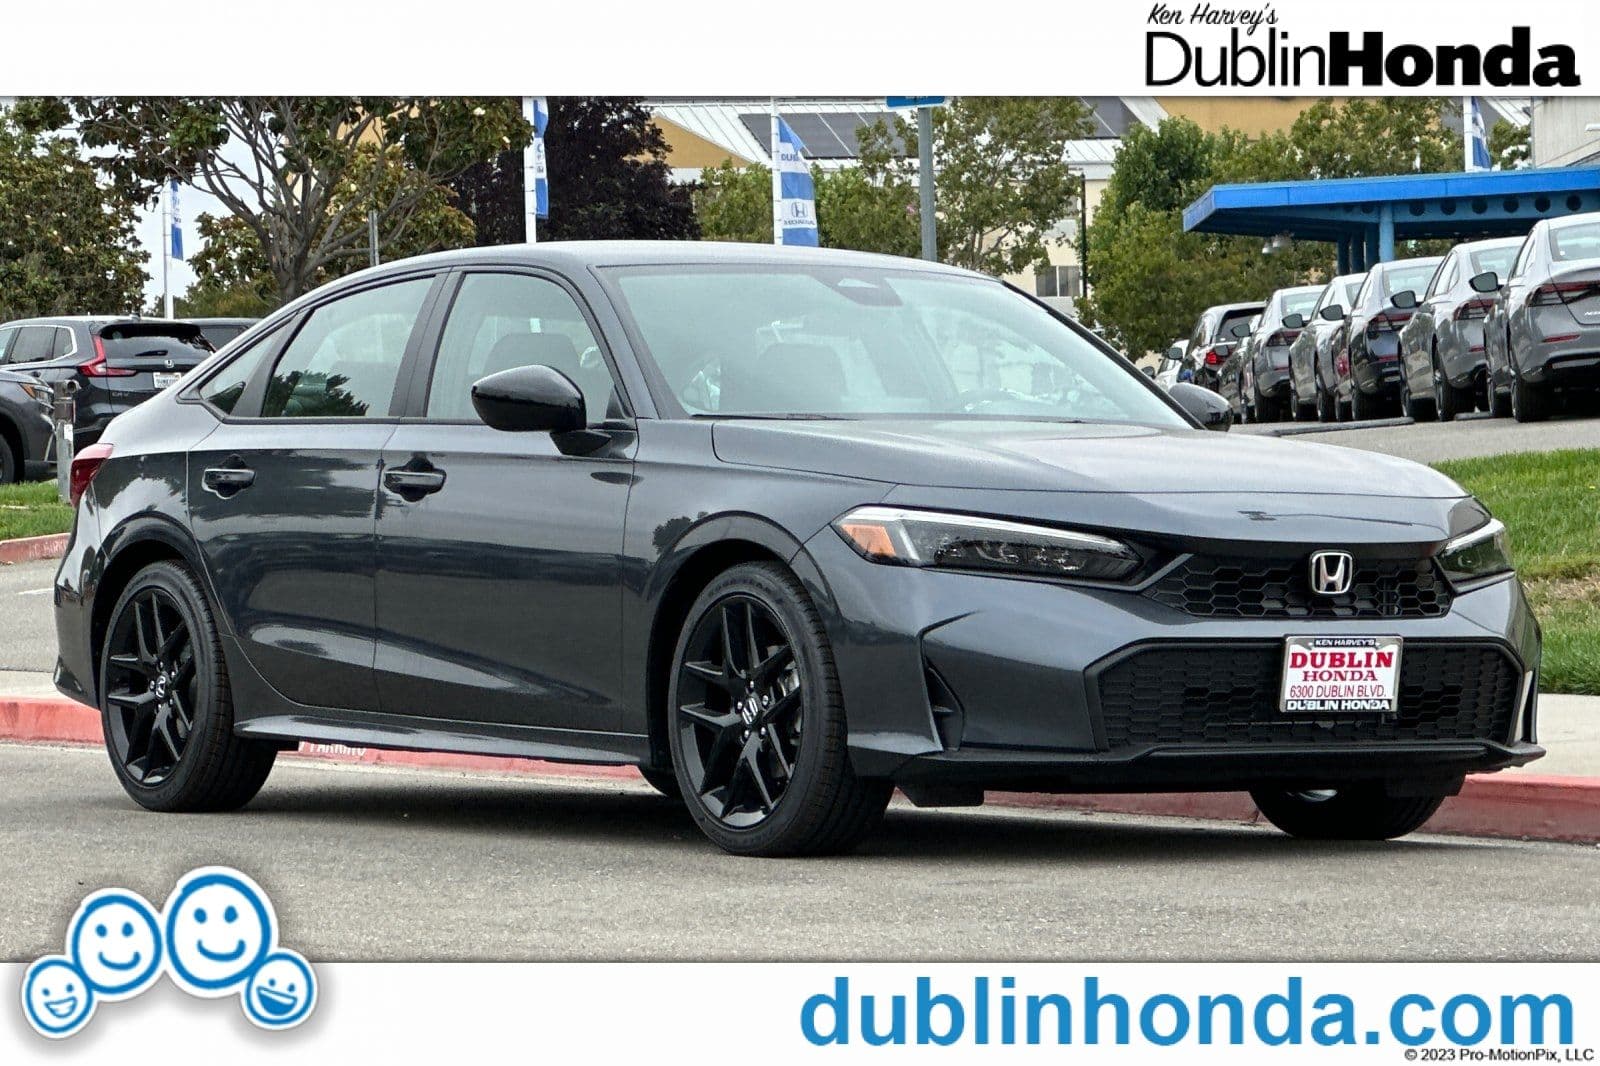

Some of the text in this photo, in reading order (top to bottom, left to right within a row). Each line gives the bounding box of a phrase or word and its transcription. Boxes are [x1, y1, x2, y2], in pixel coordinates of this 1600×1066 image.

[1334, 639, 1375, 647] HARVEY'S
[1290, 652, 1393, 669] DUBLIN
[1302, 670, 1378, 682] HONDA
[1290, 684, 1387, 698] 6300 DUBLIN BLVD.
[1287, 699, 1390, 711] DUBLIN HONDA
